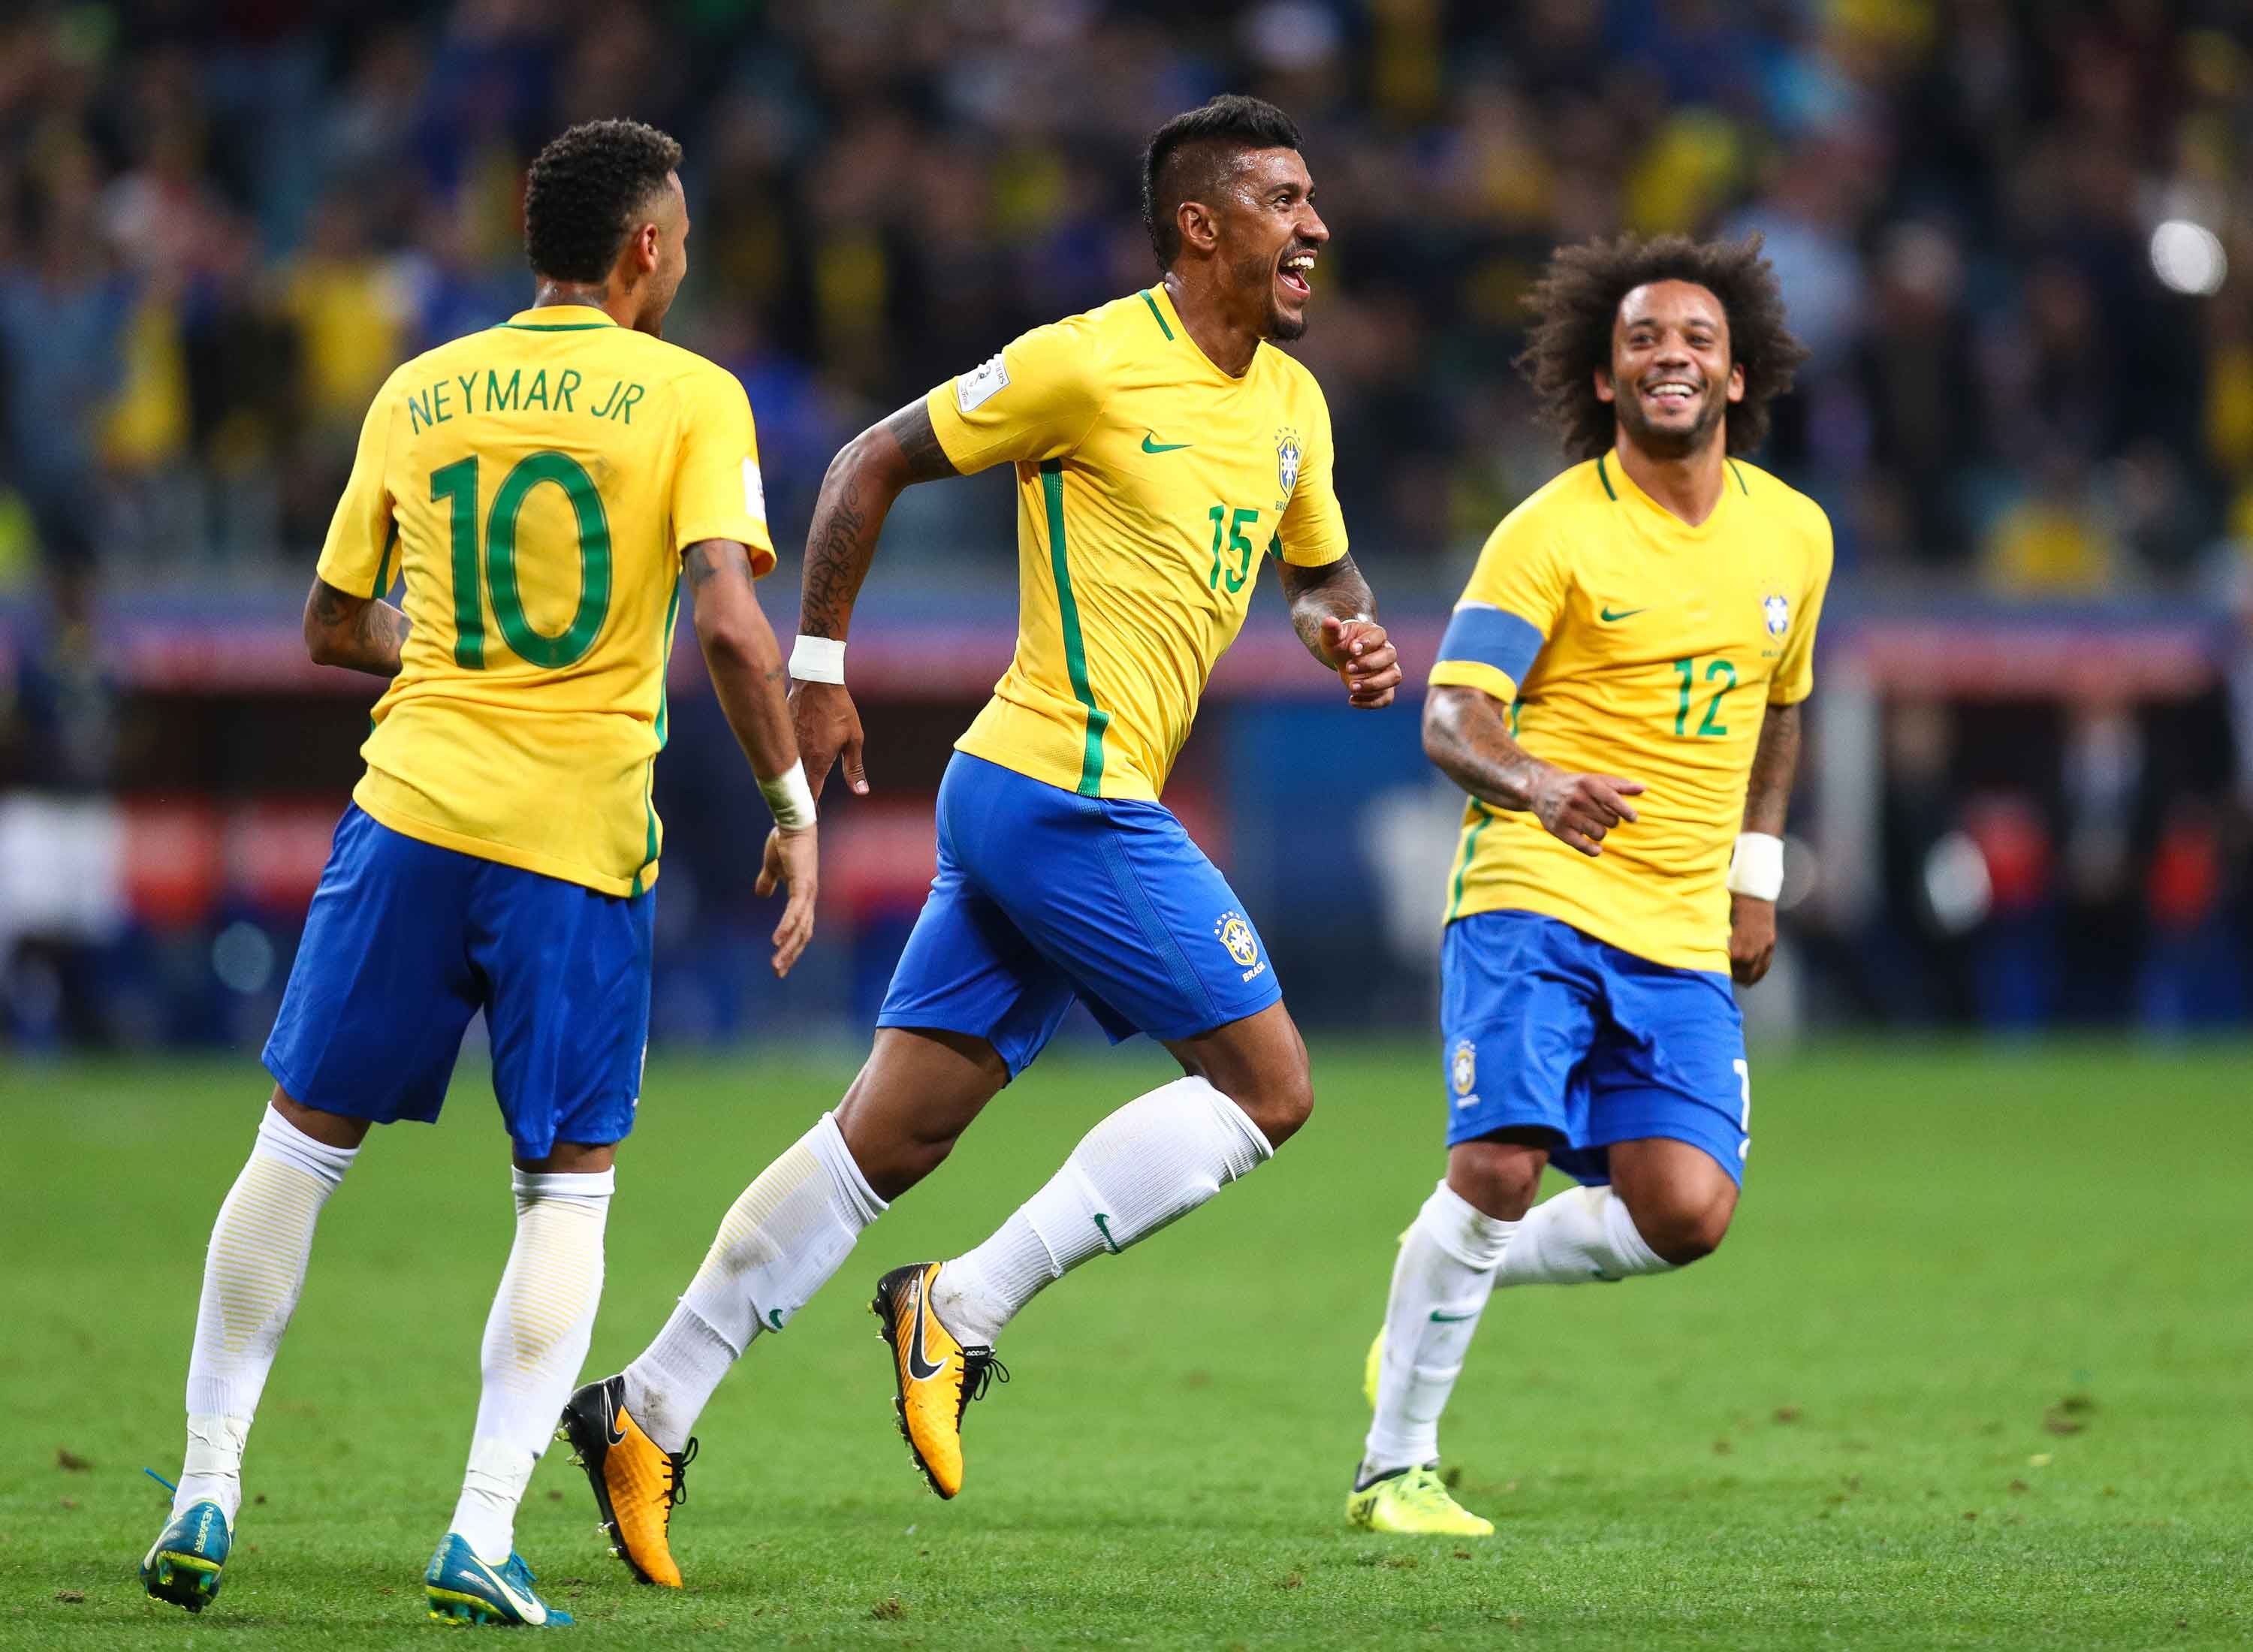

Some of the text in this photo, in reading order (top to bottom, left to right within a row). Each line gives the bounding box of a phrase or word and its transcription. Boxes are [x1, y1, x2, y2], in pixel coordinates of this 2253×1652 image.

[408, 369, 645, 434] NEYMAR JR
[1274, 500, 1289, 511] BRA
[430, 451, 611, 669] 10
[1209, 505, 1259, 593] 15
[1674, 658, 1736, 736] 12
[1241, 960, 1266, 983] BRASIL
